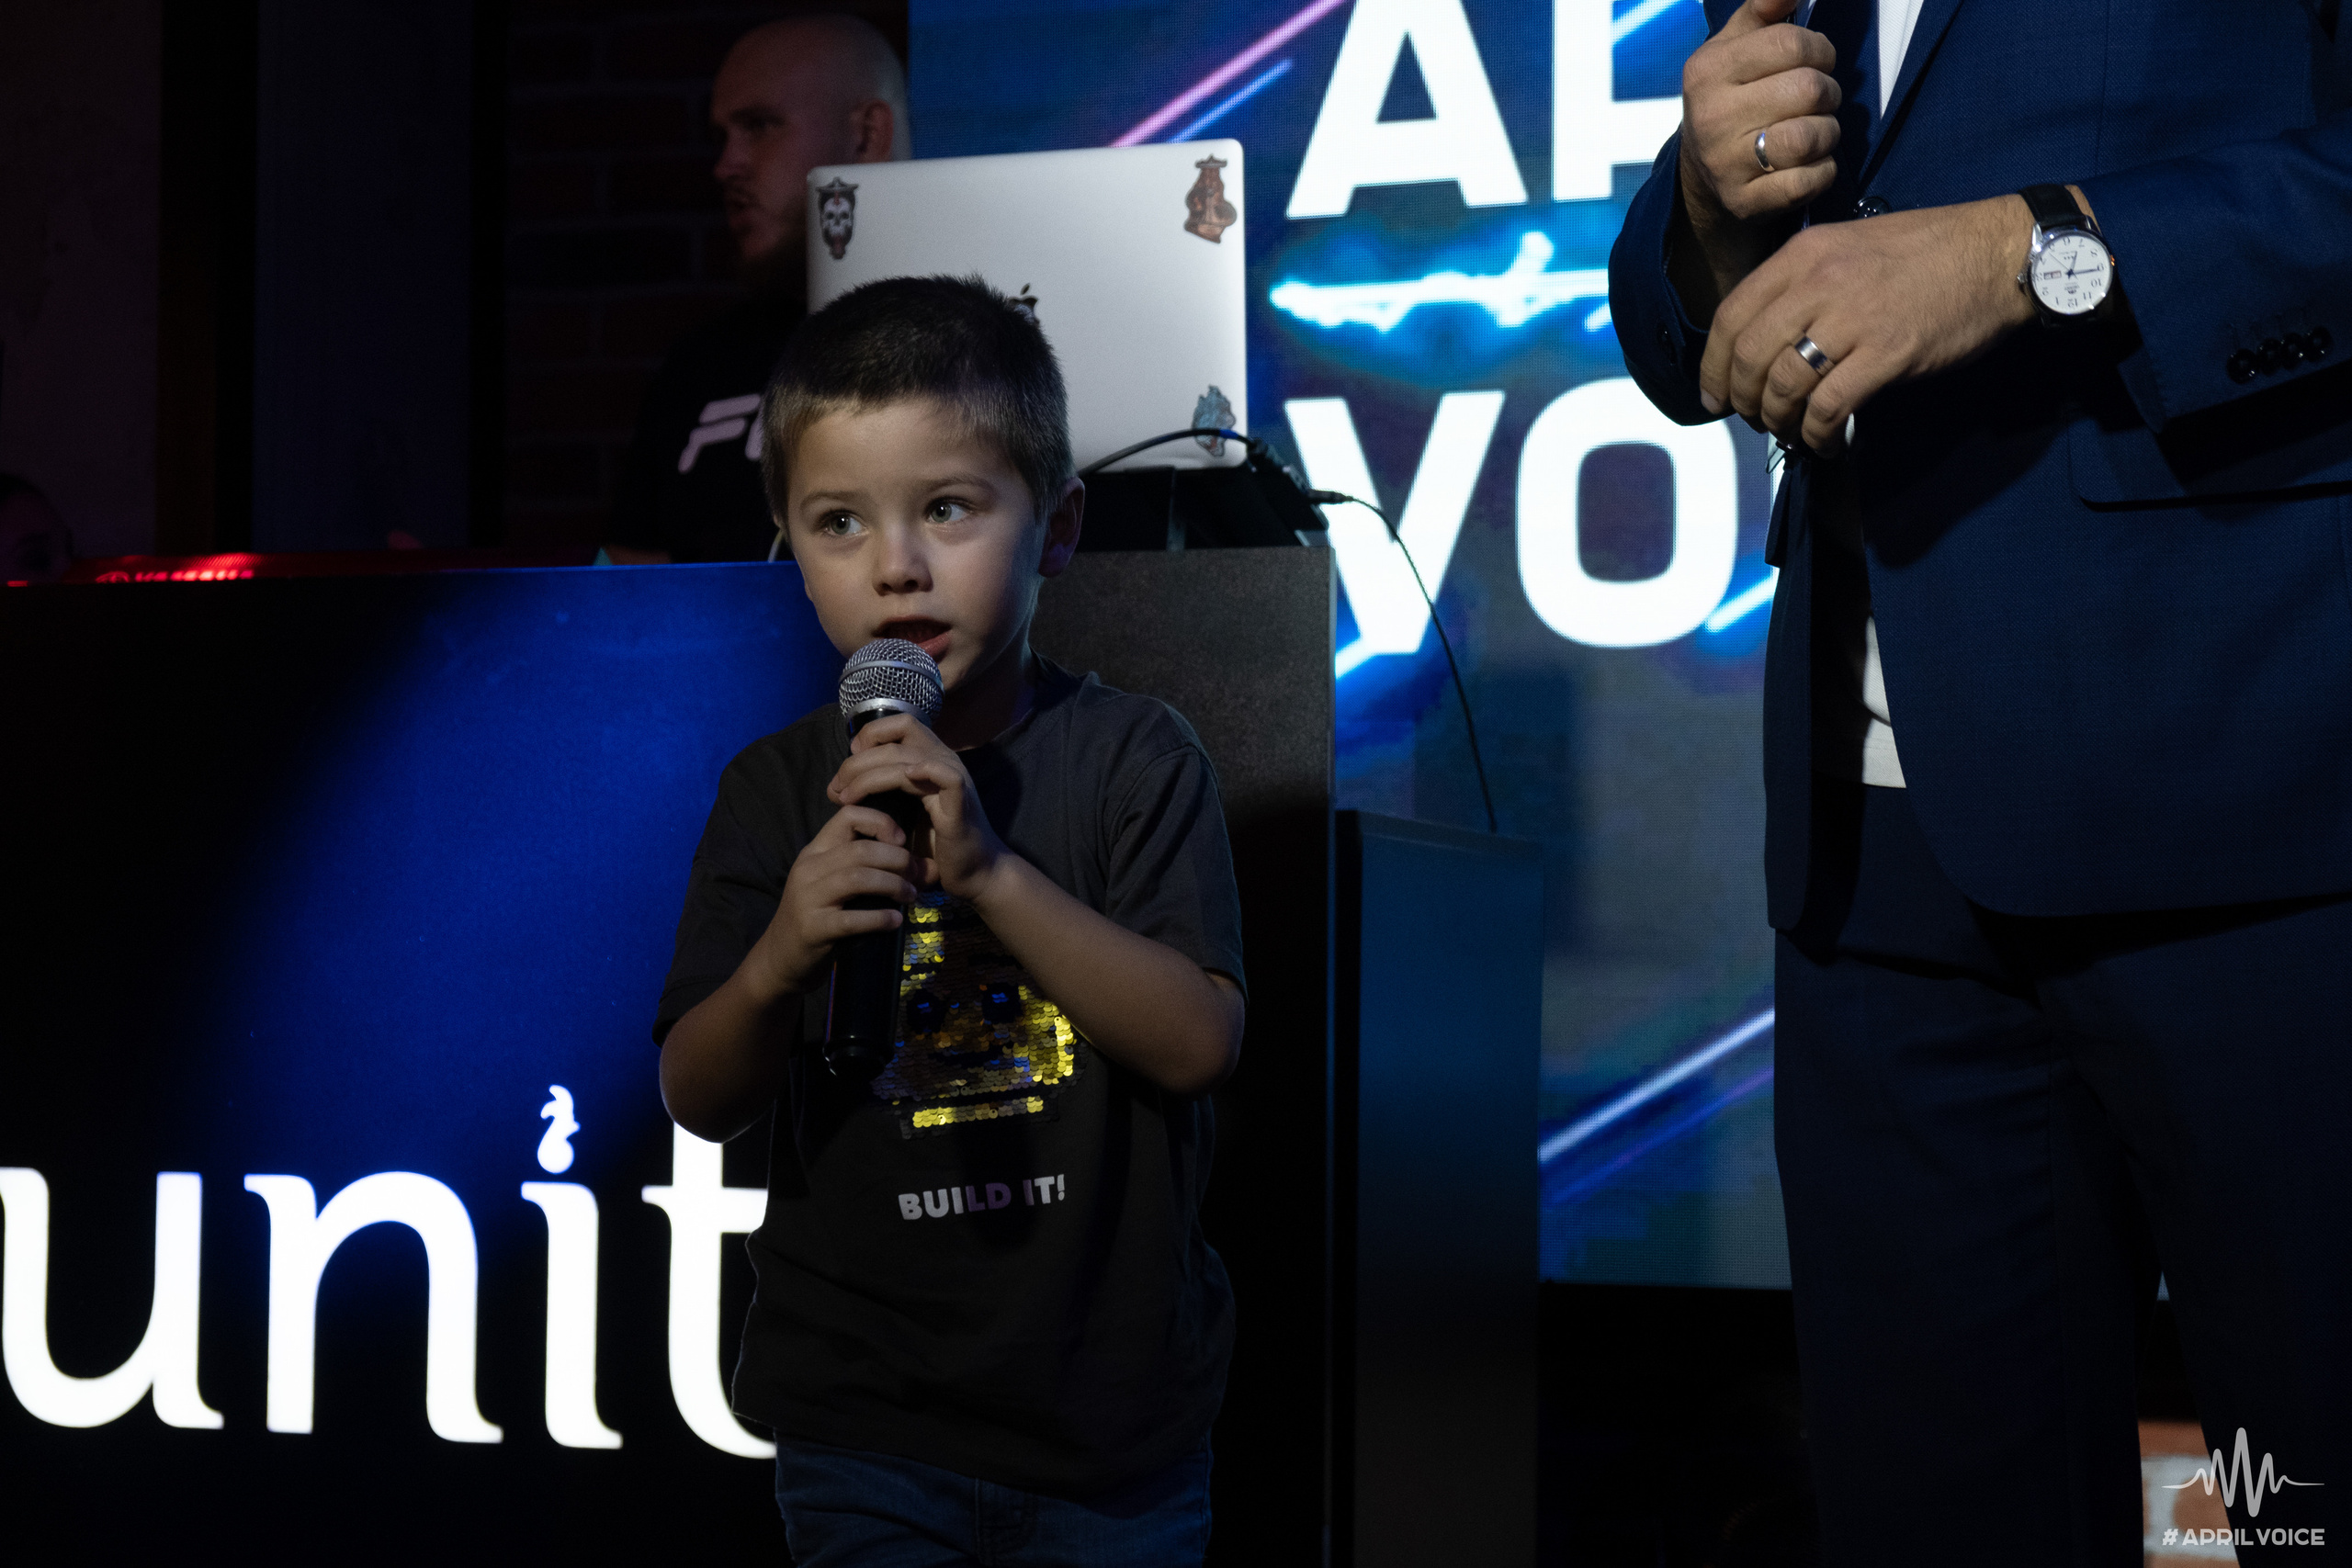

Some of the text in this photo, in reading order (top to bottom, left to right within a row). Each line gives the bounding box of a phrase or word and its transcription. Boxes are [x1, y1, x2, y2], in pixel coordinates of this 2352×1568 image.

[2067, 298, 2078, 308] 12
[898, 1173, 1066, 1221] BUILD IT!
